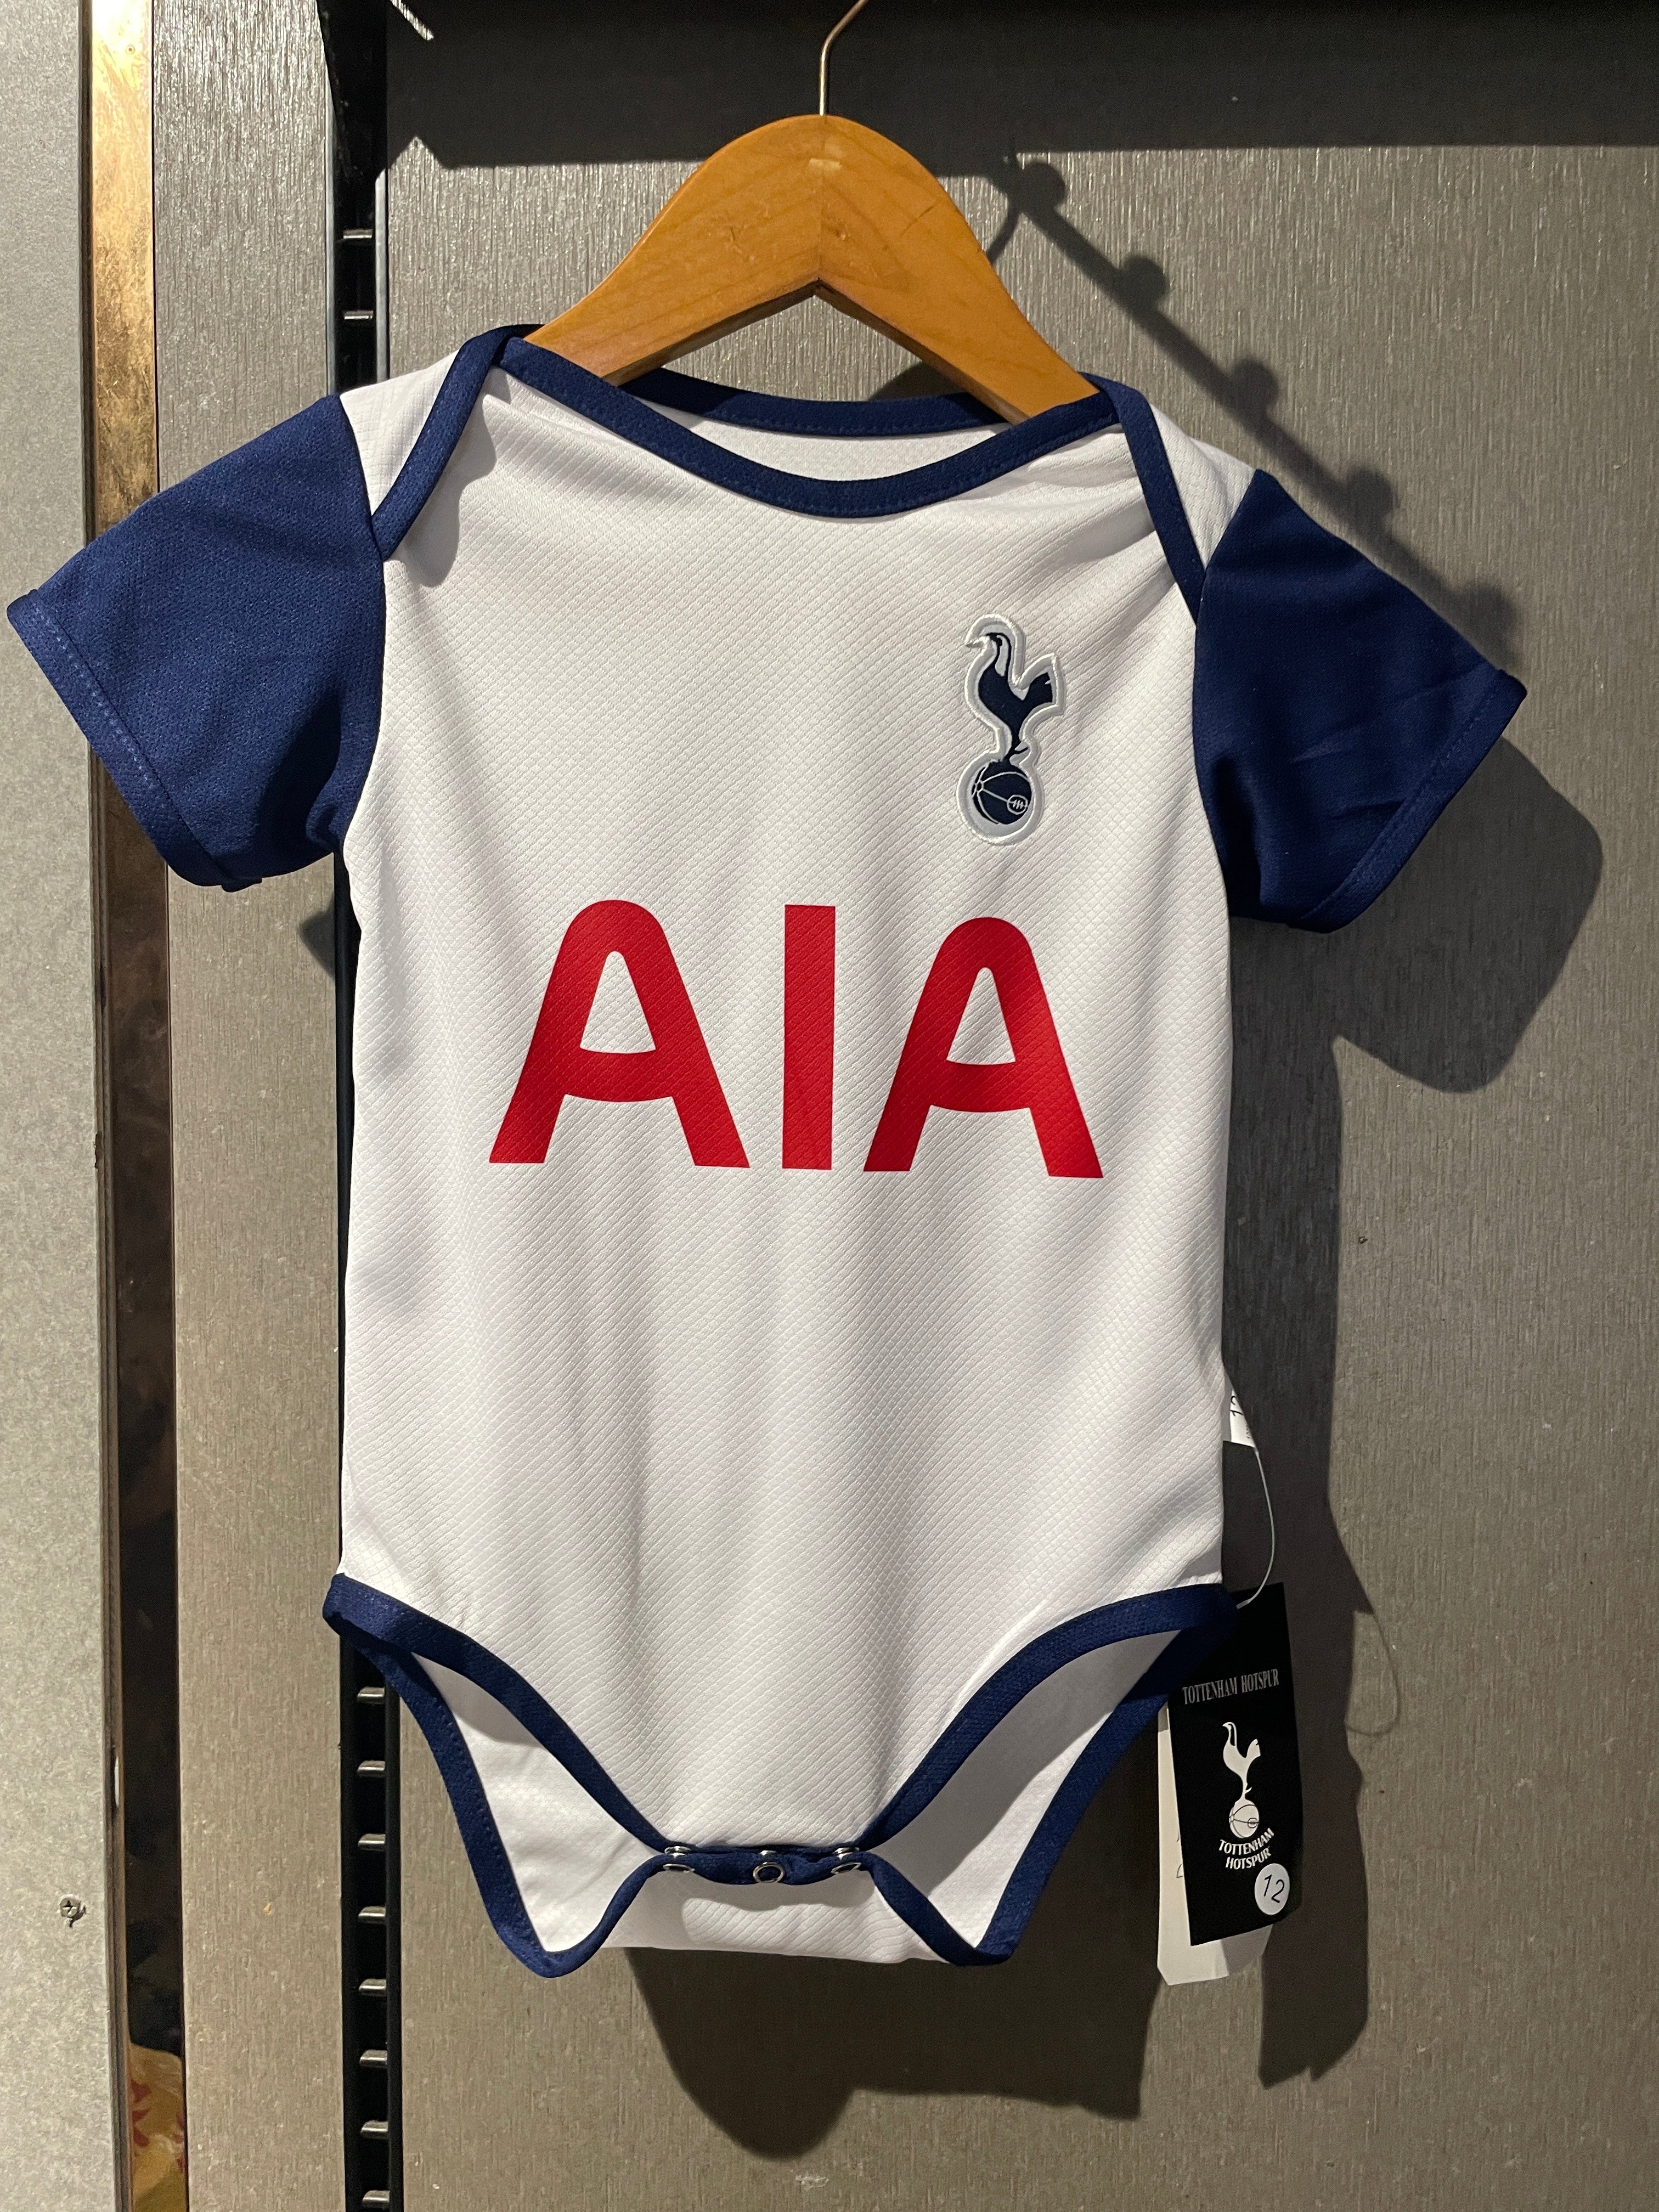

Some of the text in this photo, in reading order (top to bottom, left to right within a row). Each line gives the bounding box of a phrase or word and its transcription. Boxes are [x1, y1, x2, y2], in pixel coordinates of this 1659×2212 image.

[489, 899, 1104, 1178] AIA
[1182, 1668, 1279, 1705] TOTTENHAM HOTSPUR
[1218, 1827, 1275, 1856] TOTTENHAM
[1224, 1847, 1272, 1870] HOTSPUR
[1263, 1874, 1285, 1904] 12
